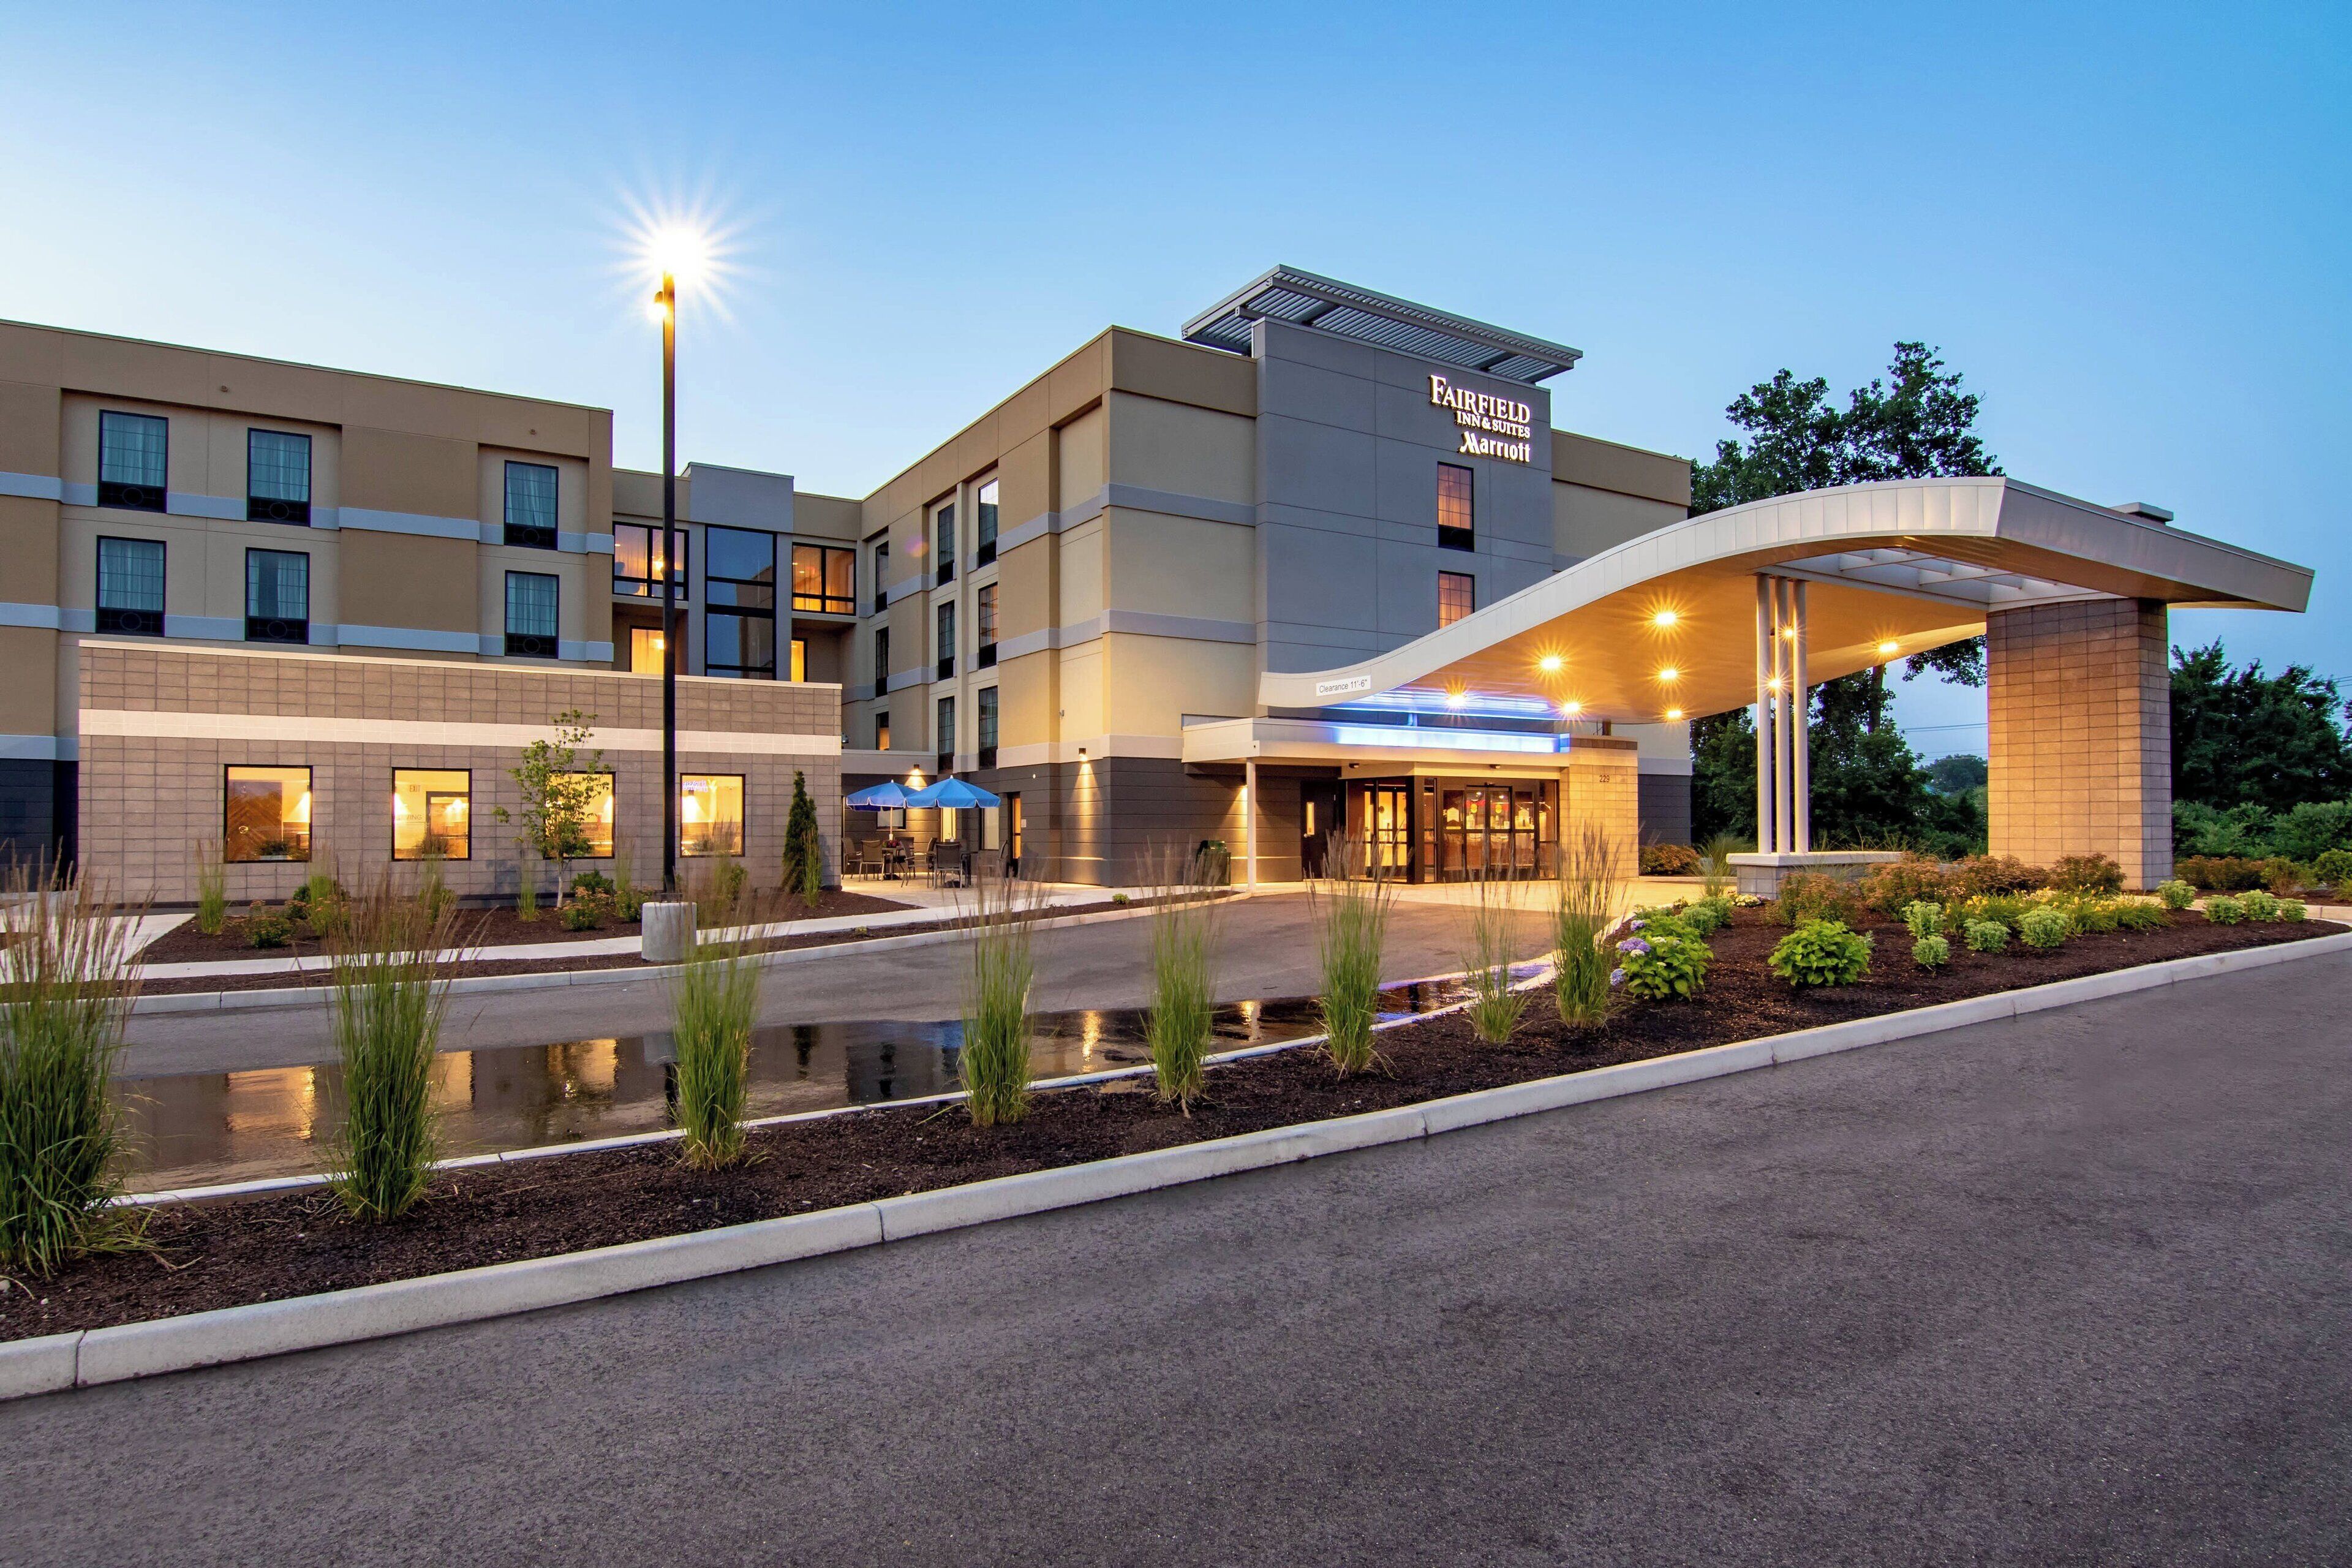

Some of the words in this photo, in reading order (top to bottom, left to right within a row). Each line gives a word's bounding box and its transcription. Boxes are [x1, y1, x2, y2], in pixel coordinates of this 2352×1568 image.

[1430, 374, 1531, 424] FAIRFIELD
[1456, 410, 1481, 428] INN
[1482, 417, 1491, 430] &
[1492, 419, 1531, 439] SUITES
[1459, 431, 1531, 462] Marriott
[1319, 683, 1349, 693] Clearance
[1350, 679, 1368, 688] 11'-6"
[1599, 774, 1610, 783] 229
